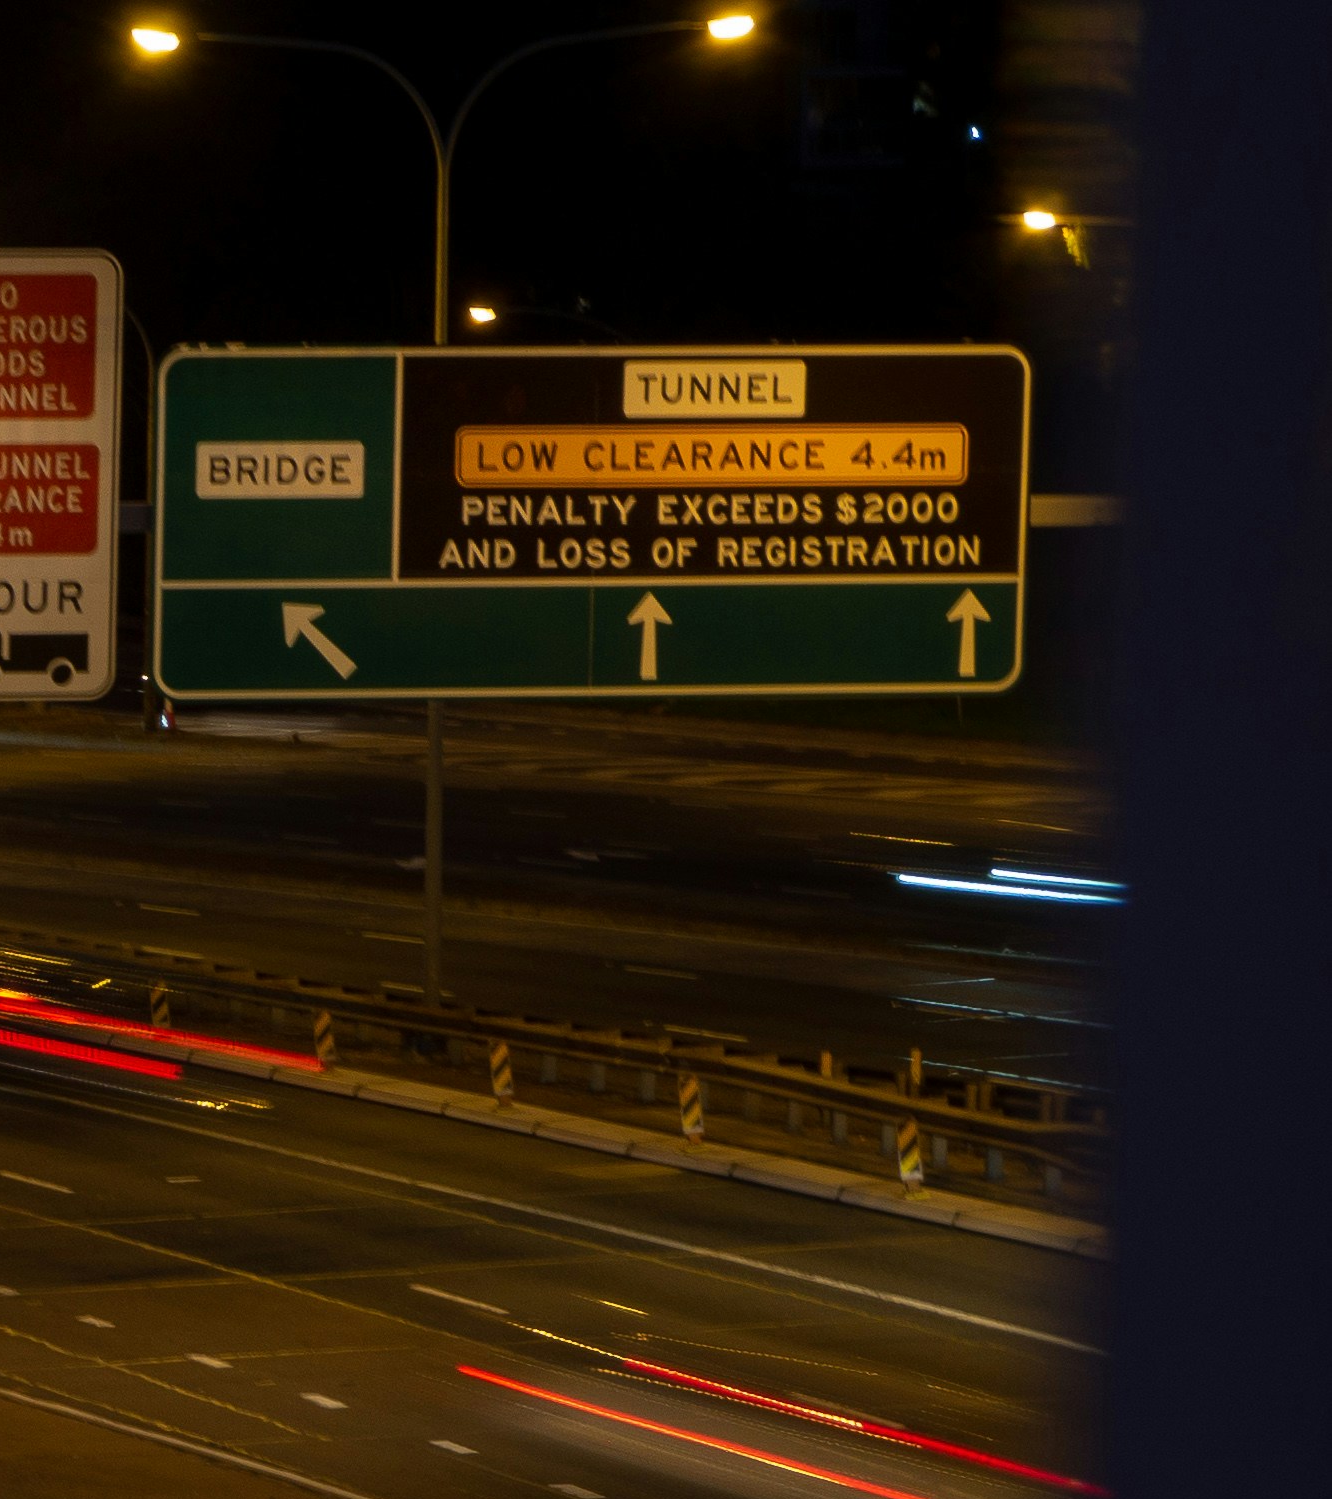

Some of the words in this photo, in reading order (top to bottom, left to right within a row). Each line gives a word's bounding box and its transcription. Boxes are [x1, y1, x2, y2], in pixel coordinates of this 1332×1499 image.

[638, 375, 790, 403] TUNNEL
[210, 456, 350, 485] BRIDGE
[478, 443, 556, 471] LOW
[583, 441, 823, 472] CLEARANCE
[852, 442, 945, 469] 4.4m
[463, 496, 635, 524] PENALTY
[658, 495, 822, 524] EXCEEDS
[837, 494, 958, 524] $2000
[440, 540, 515, 567] AND
[538, 539, 630, 568] LOSS
[652, 539, 696, 567] OF
[718, 537, 979, 566] REGISTRATION
